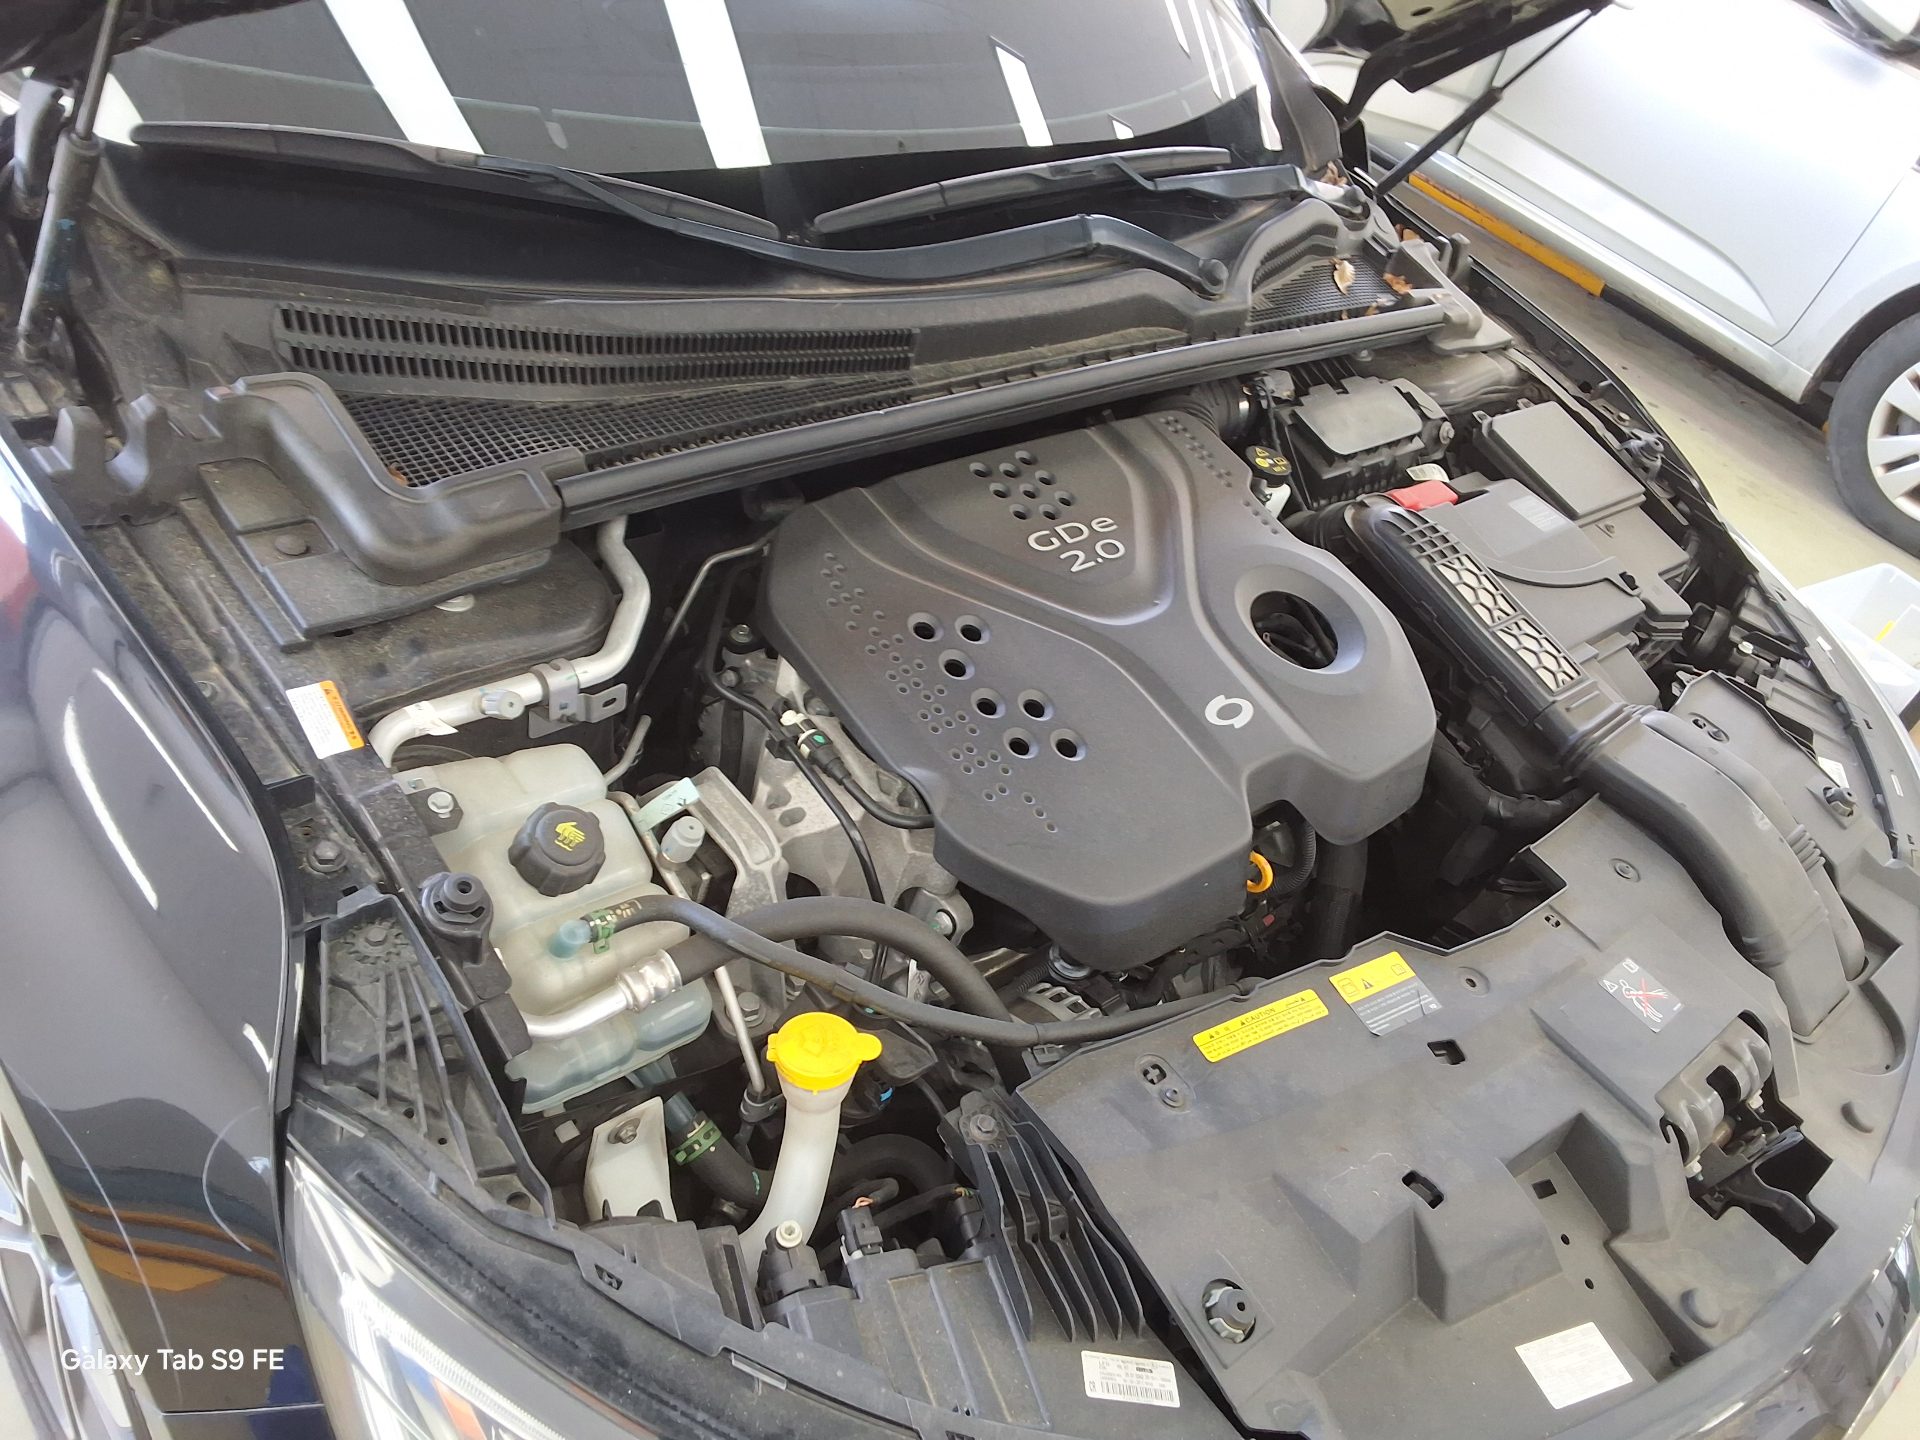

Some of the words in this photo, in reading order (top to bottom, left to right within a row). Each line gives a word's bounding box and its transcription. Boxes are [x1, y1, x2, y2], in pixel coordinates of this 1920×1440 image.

[1027, 517, 1119, 552] GDe
[1059, 538, 1126, 573] 2.0
[1245, 1007, 1276, 1023] CAUTION
